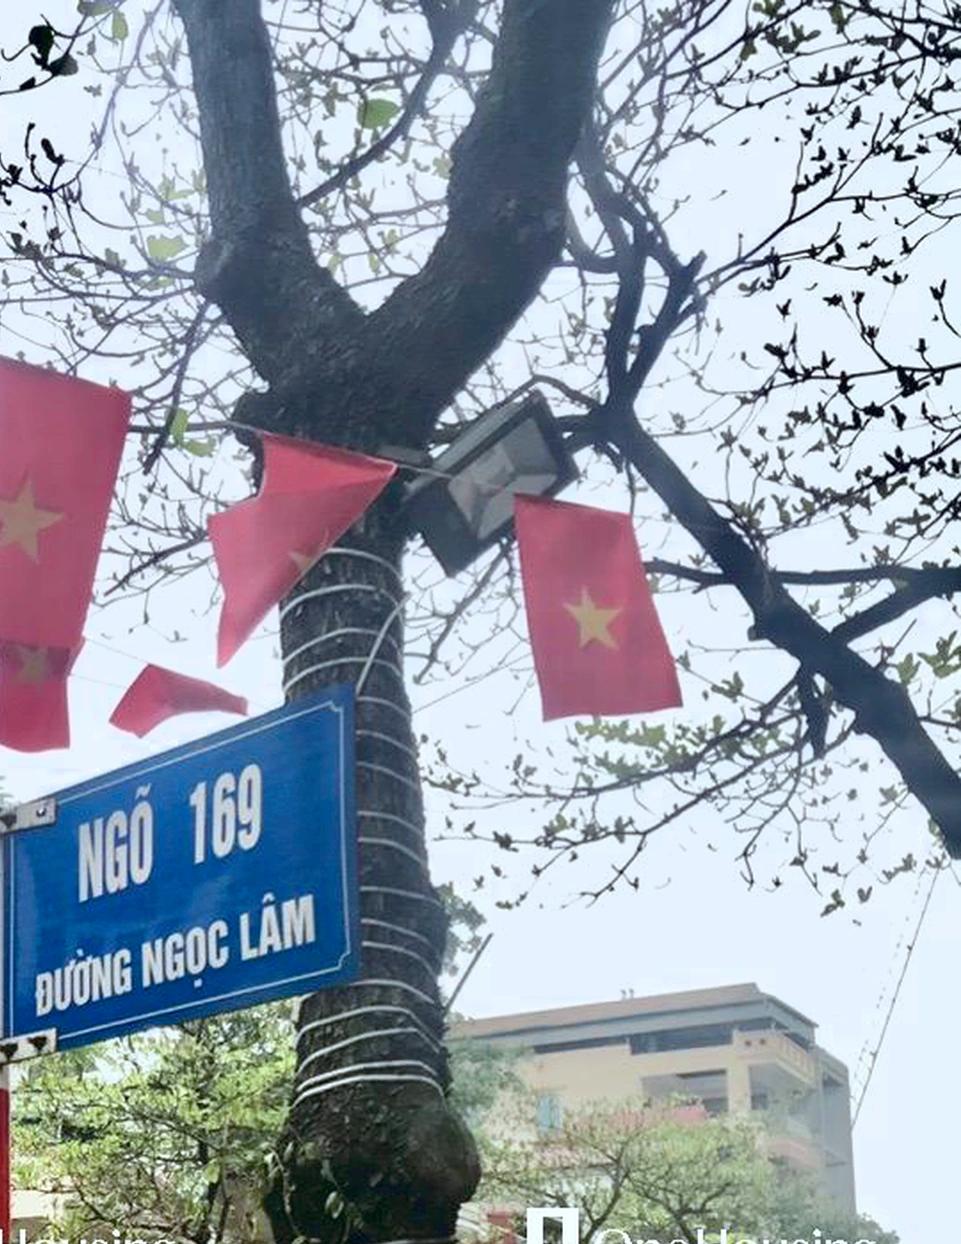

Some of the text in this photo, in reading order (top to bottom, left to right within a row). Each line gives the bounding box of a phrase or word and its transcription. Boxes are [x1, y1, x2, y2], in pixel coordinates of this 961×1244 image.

[78, 764, 262, 902] NGÕ 169
[35, 892, 316, 1017] ĐƯỜNG NGỌC LÂM
